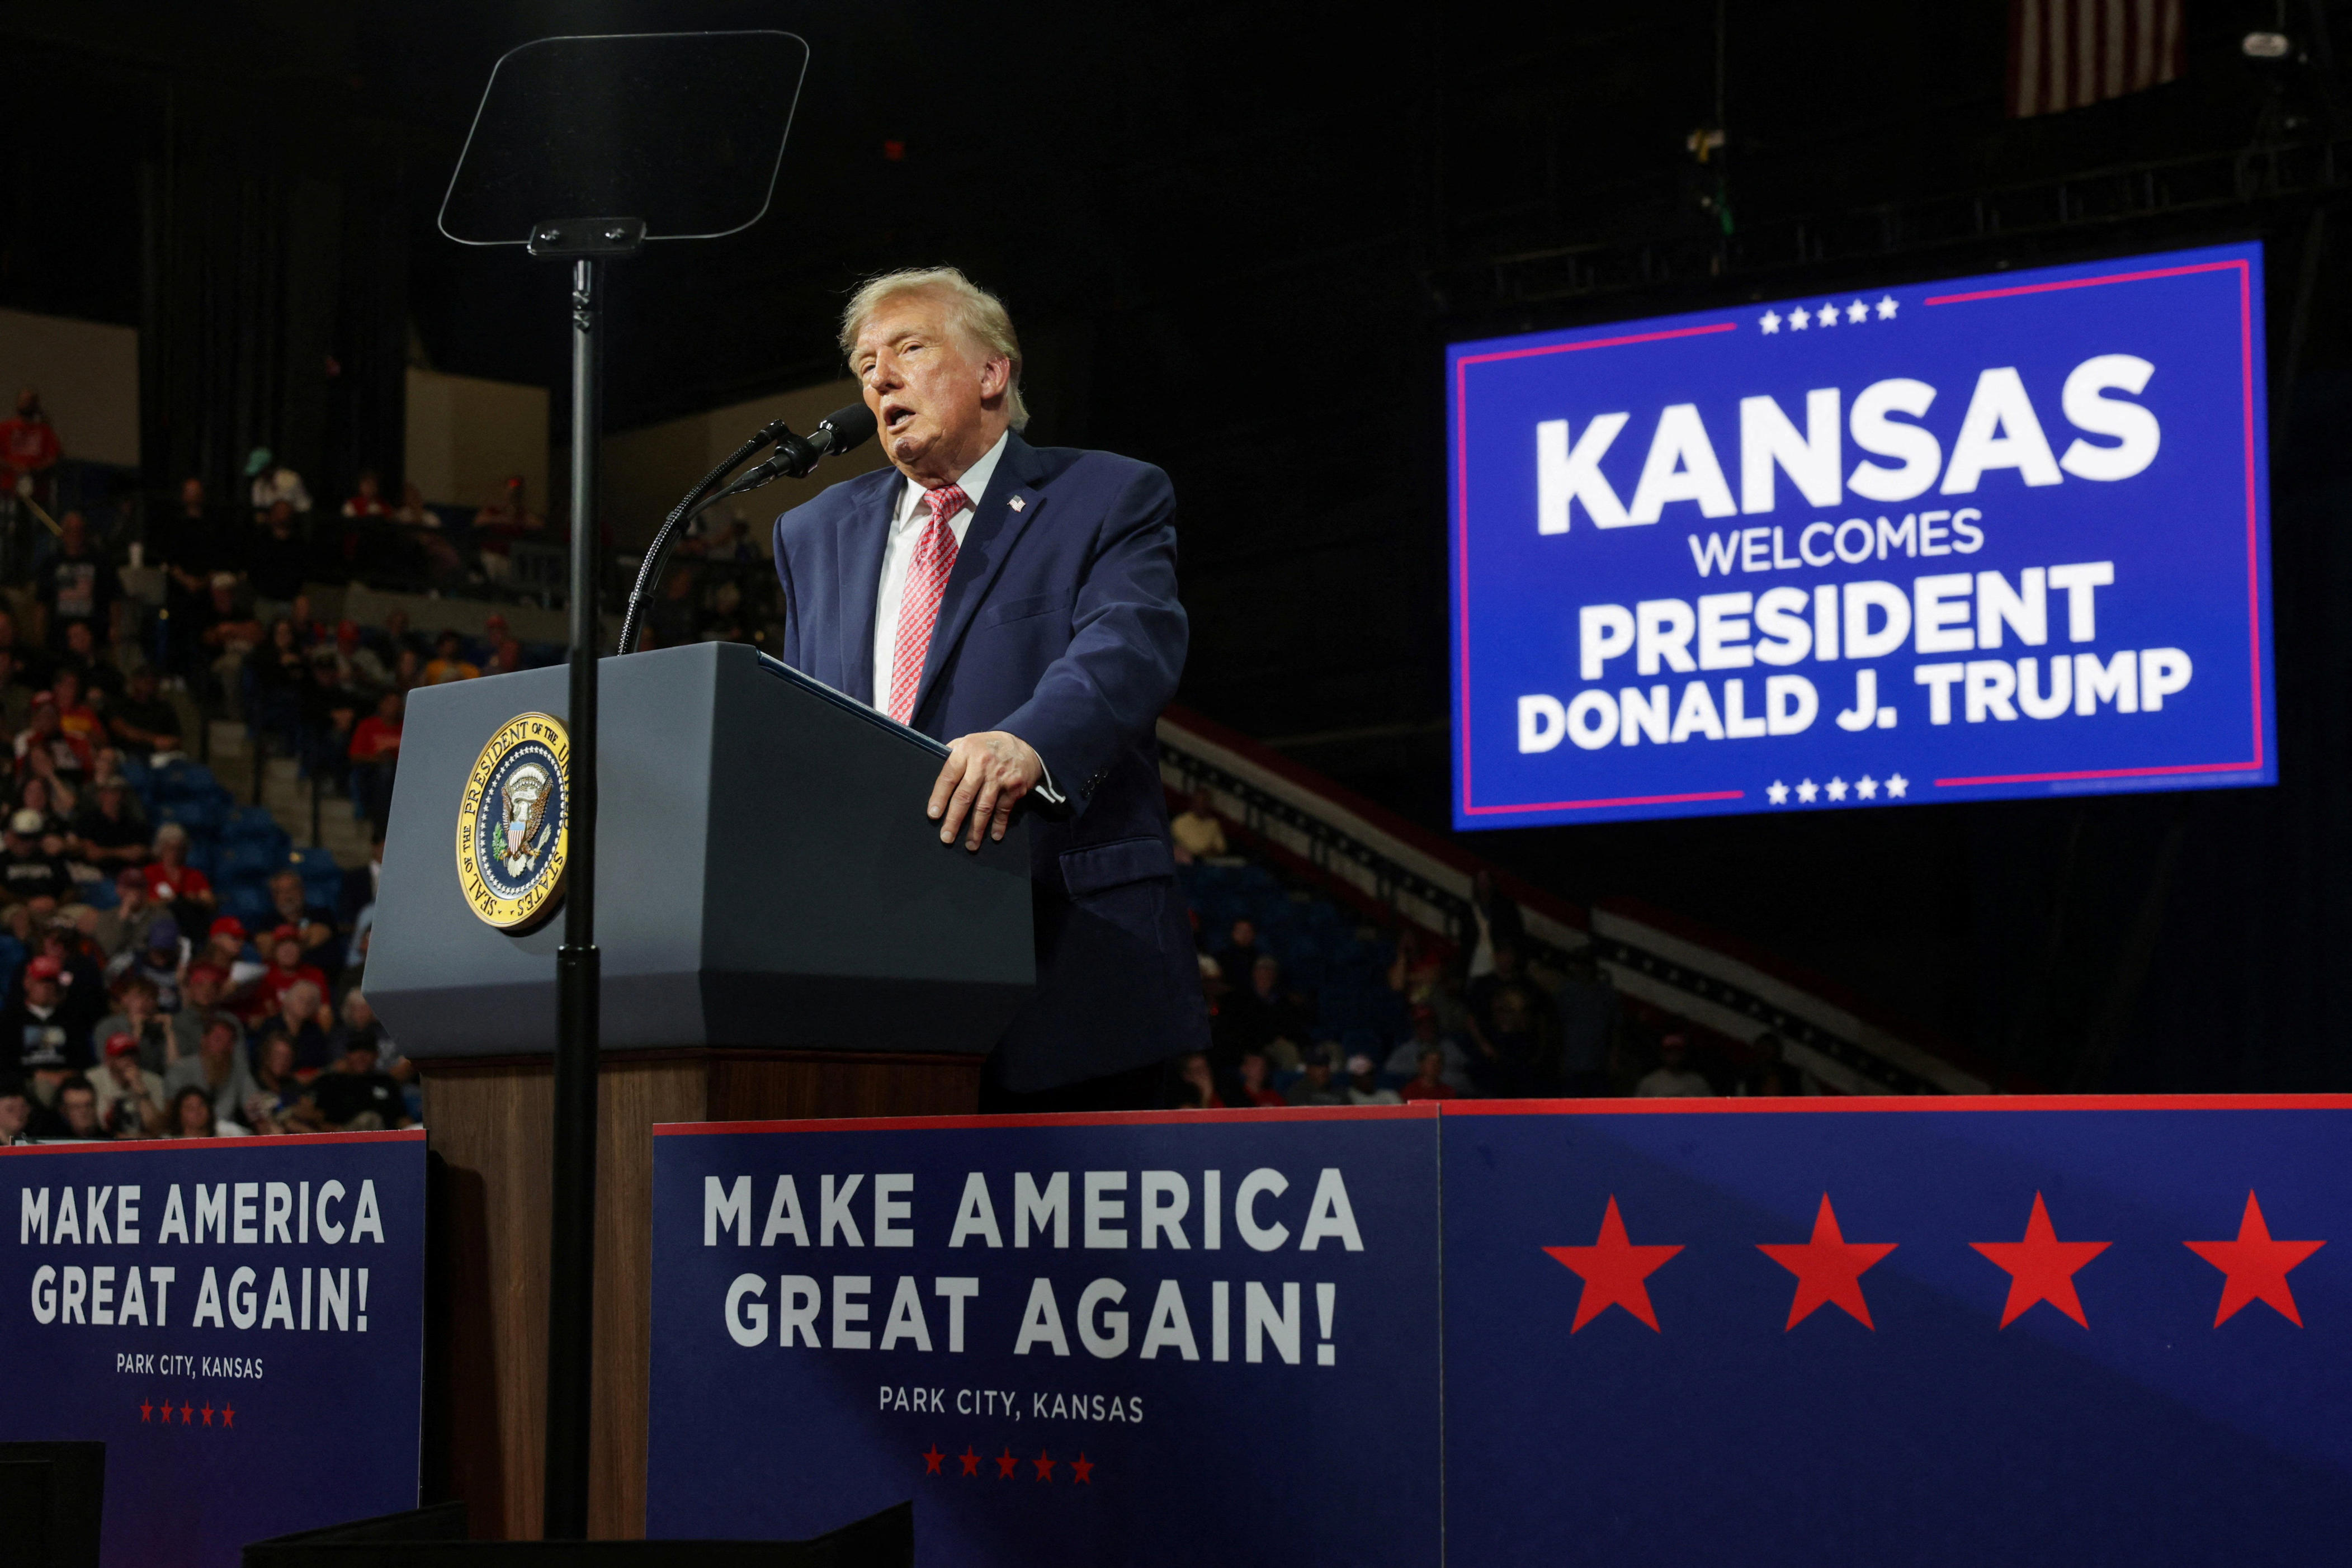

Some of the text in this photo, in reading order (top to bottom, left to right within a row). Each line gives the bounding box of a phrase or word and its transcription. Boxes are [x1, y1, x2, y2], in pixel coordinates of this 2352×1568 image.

[1536, 353, 2161, 536] KANSAS
[1688, 507, 1985, 578] WELCOMES
[1579, 560, 2115, 681] PRESIDENT
[532, 722, 543, 735] OF
[1517, 647, 2193, 754] DONALD J. TRUMP
[464, 721, 528, 816] PRESIDENT
[545, 726, 559, 746] THE
[463, 823, 471, 854] THE
[464, 857, 474, 873] OF
[469, 873, 497, 916] SEAL
[517, 851, 564, 916] STATES
[20, 1179, 385, 1245] MAKE AMERICA
[704, 1168, 1364, 1252] MAKE AMERICA
[31, 1264, 369, 1332] GREAT AGAIN!
[725, 1273, 1335, 1366] GREAT AGAIN!
[117, 1353, 263, 1380] PARK CITY, KANSAS
[880, 1386, 1143, 1423] PARK CITY, KANSAS
